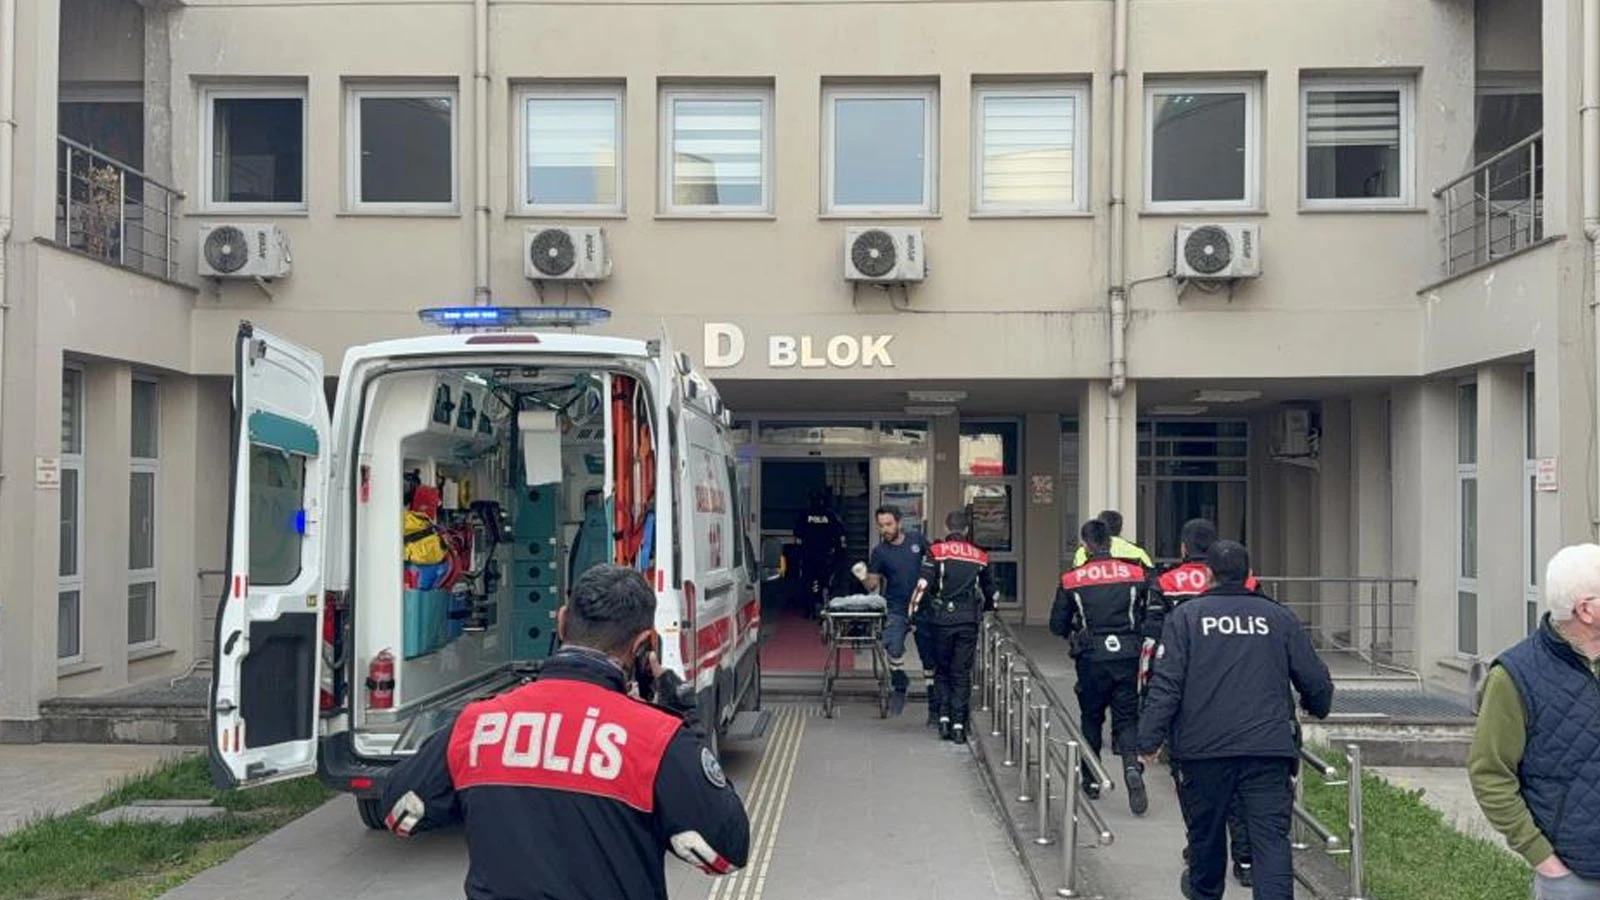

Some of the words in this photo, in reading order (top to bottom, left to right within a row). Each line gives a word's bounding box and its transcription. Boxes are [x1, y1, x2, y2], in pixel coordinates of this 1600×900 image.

[703, 322, 746, 368] D
[769, 334, 896, 367] BLOK
[1202, 616, 1270, 636] POLİS
[469, 706, 628, 780] POLİS
